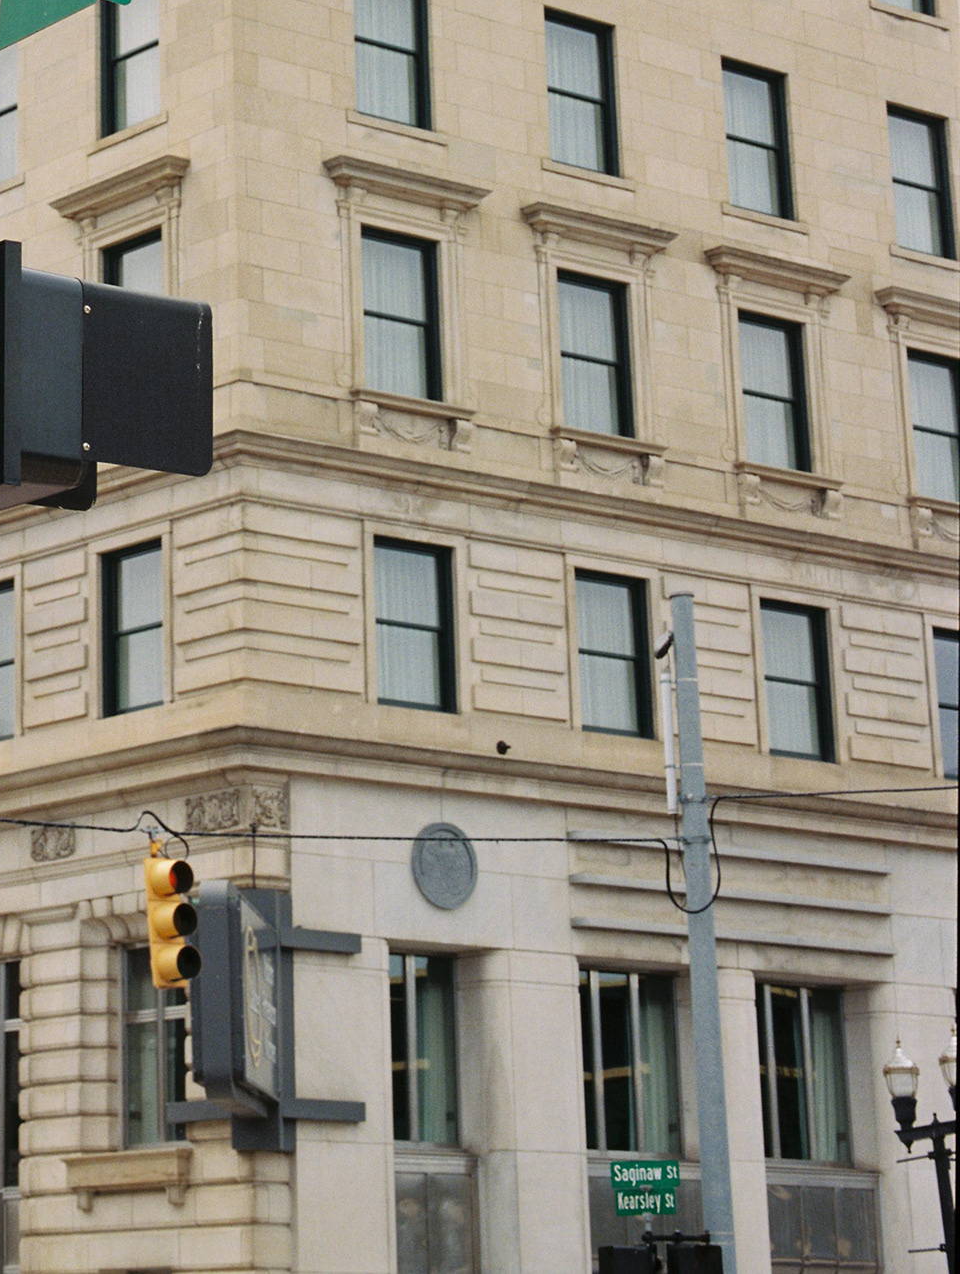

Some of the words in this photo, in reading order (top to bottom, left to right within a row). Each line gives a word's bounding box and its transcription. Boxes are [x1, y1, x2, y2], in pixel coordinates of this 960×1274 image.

[613, 1164, 662, 1186] Saginaw
[666, 1165, 678, 1179] St
[617, 1192, 661, 1213] Kearsley
[665, 1193, 675, 1208] St
